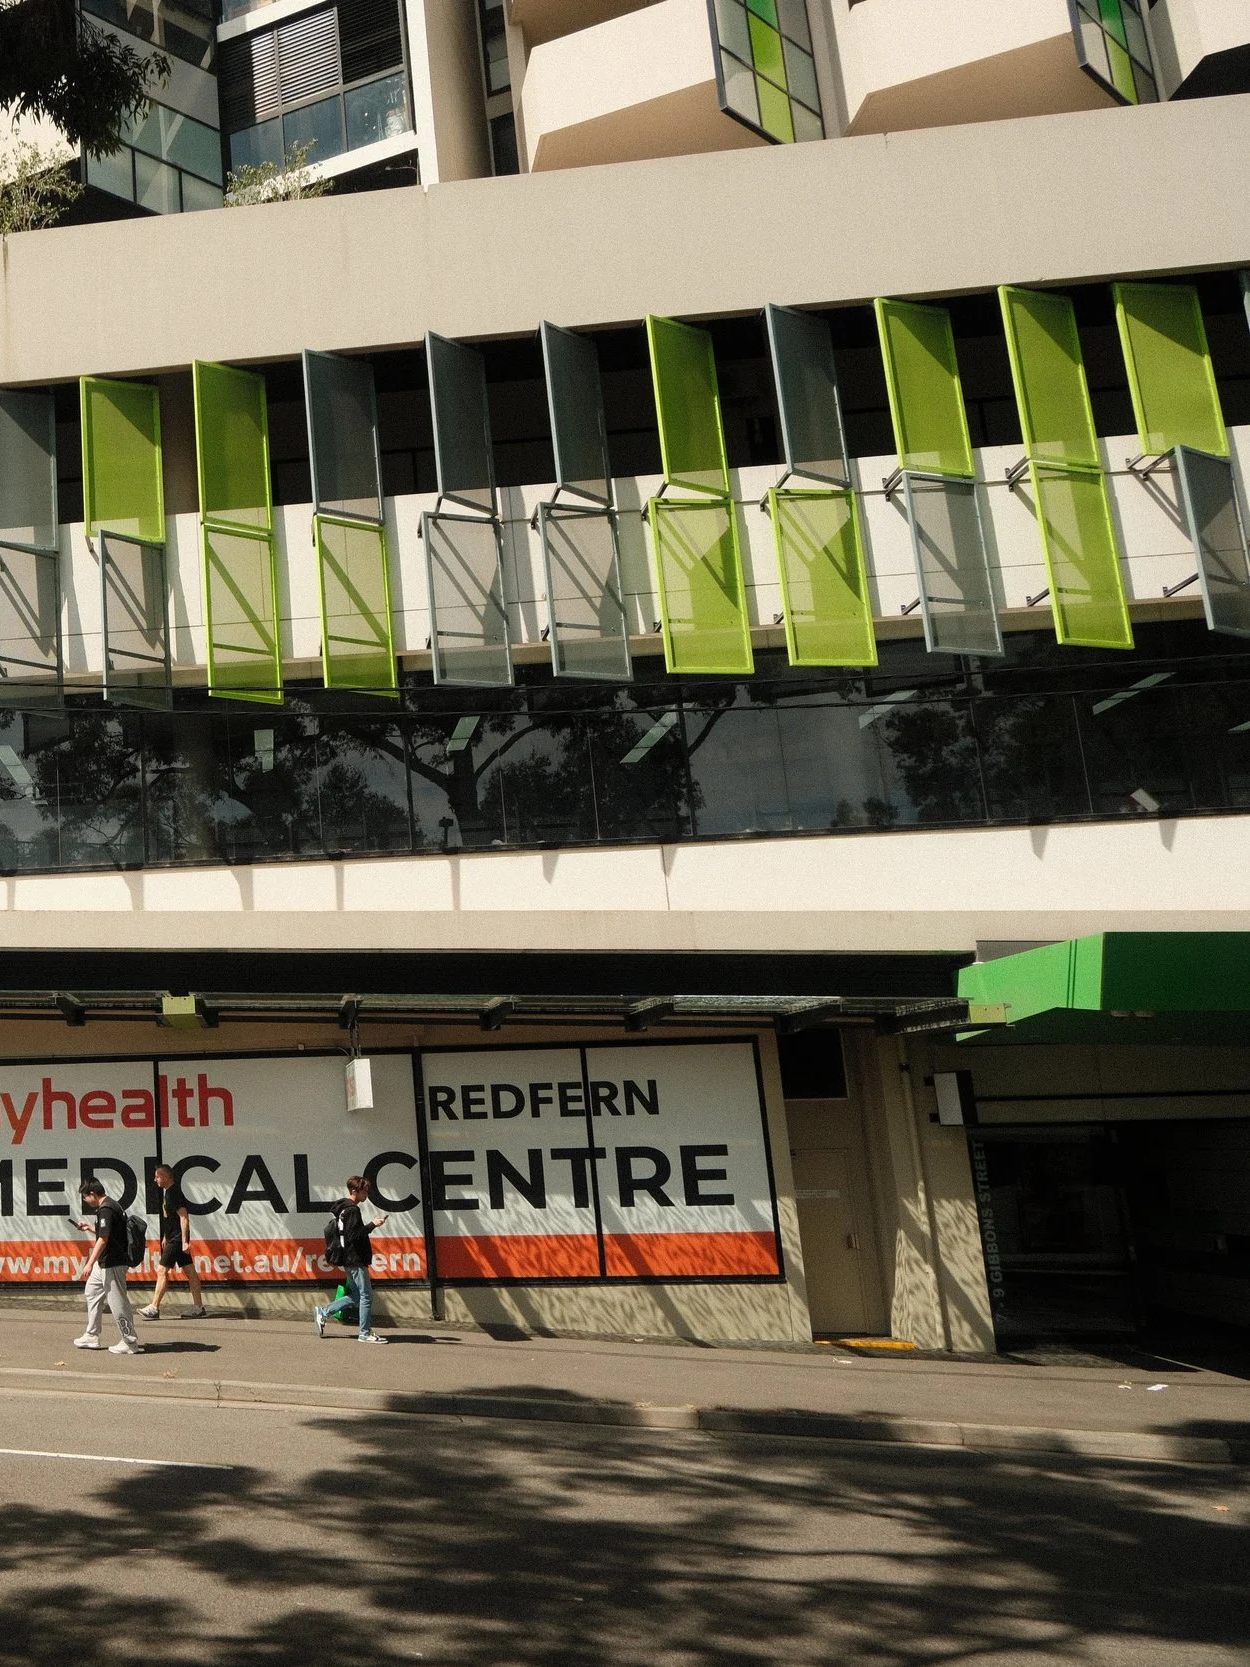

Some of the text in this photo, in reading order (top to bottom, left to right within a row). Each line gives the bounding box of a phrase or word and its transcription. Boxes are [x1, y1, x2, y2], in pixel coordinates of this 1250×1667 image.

[428, 1079, 660, 1121] REDFERN
[362, 1143, 736, 1213] CENTRE
[972, 1140, 991, 1202] STREET
[981, 1208, 1004, 1284] GIBBONS
